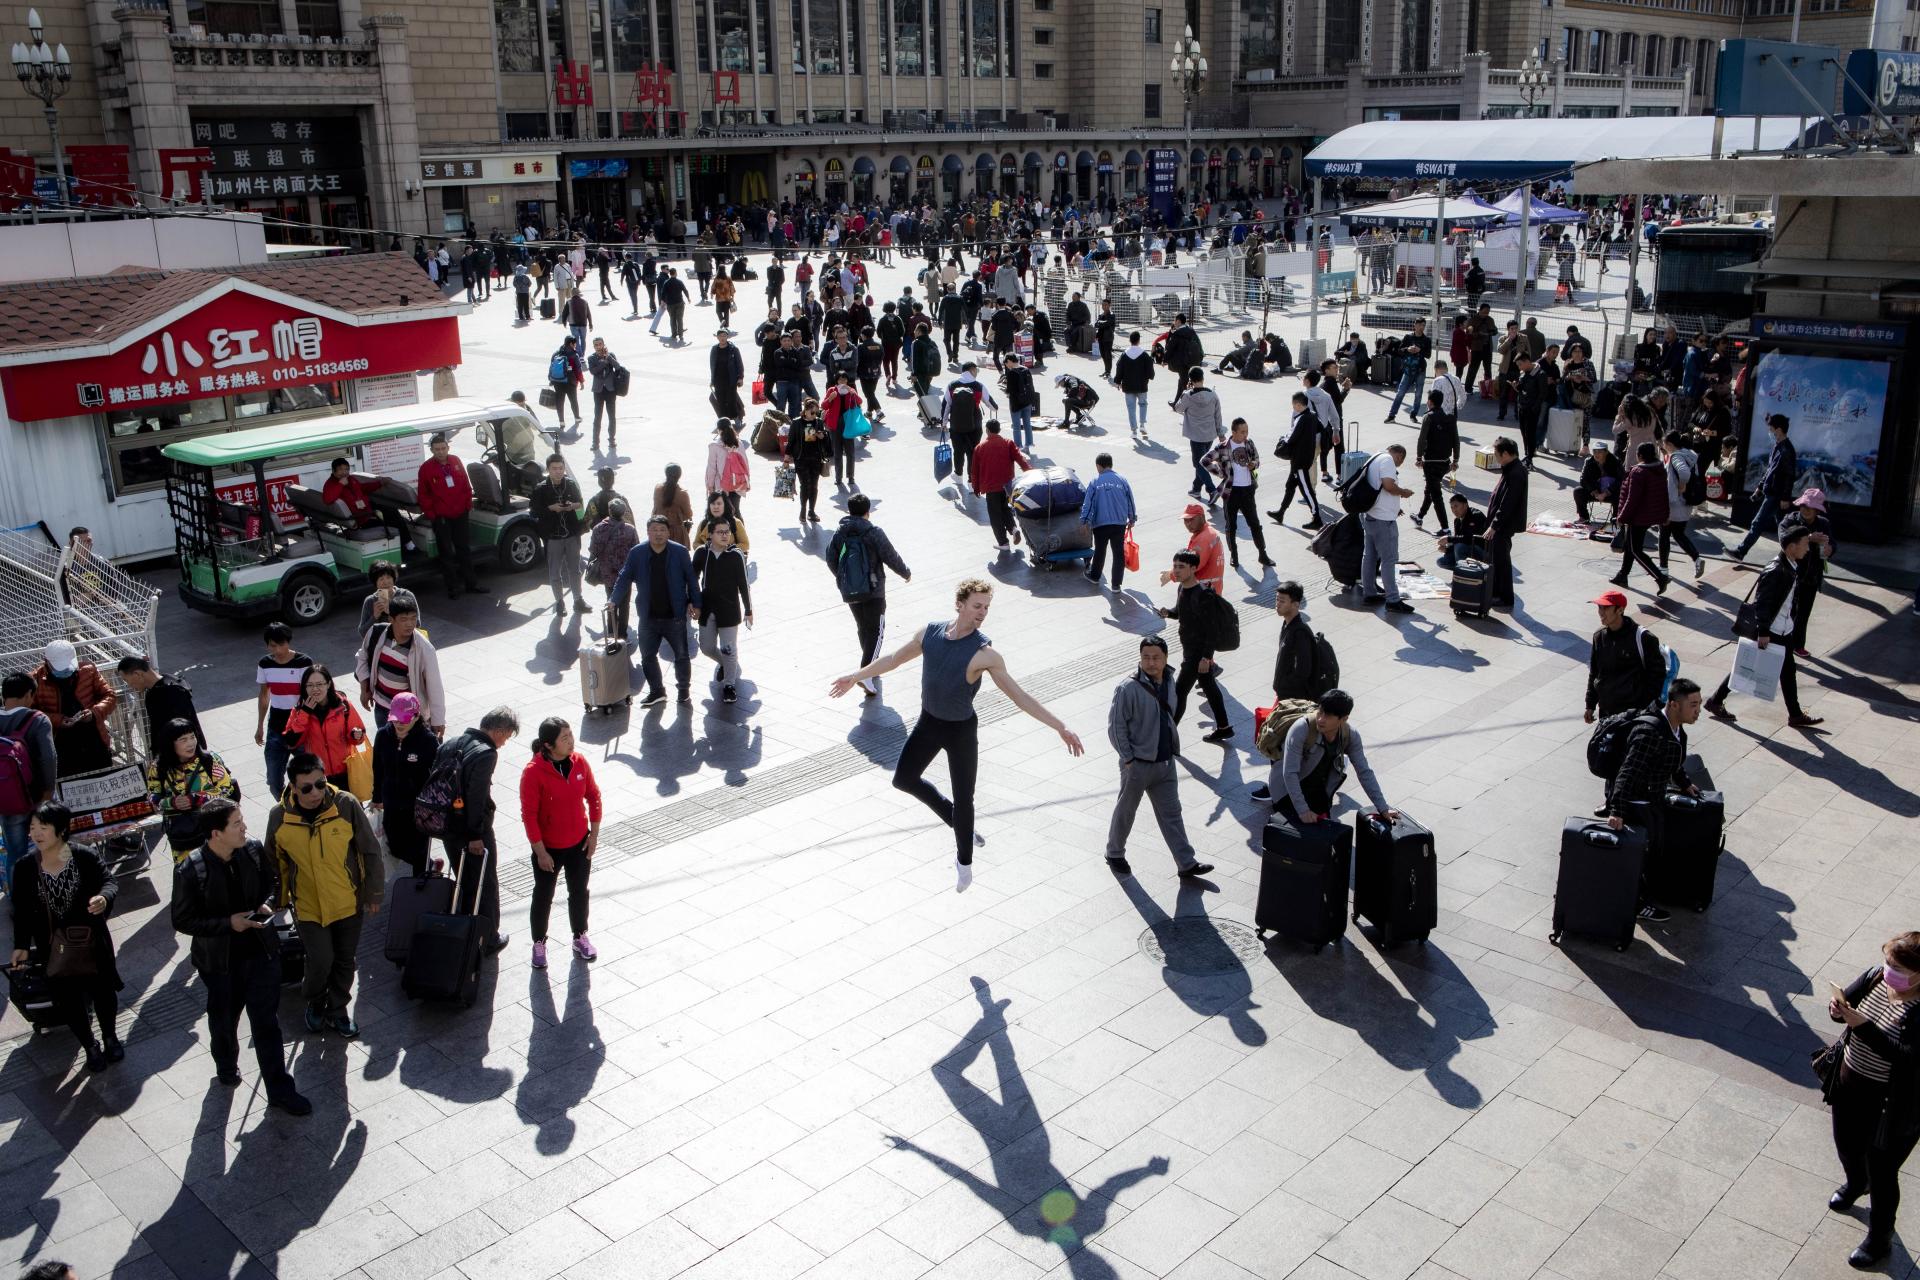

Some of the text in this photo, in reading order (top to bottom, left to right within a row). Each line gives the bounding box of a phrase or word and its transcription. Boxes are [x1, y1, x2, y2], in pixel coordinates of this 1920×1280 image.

[556, 60, 740, 106] 出站口
[195, 121, 313, 141] 网吧 寄存
[622, 111, 689, 131] EXIT
[209, 147, 316, 168] 联超市
[424, 161, 544, 178] 空售票 超市
[141, 317, 322, 377] 小红帽
[108, 358, 369, 405] 搬运服务处 服务热线: 010-51834569
[216, 487, 258, 503] 共卫生
